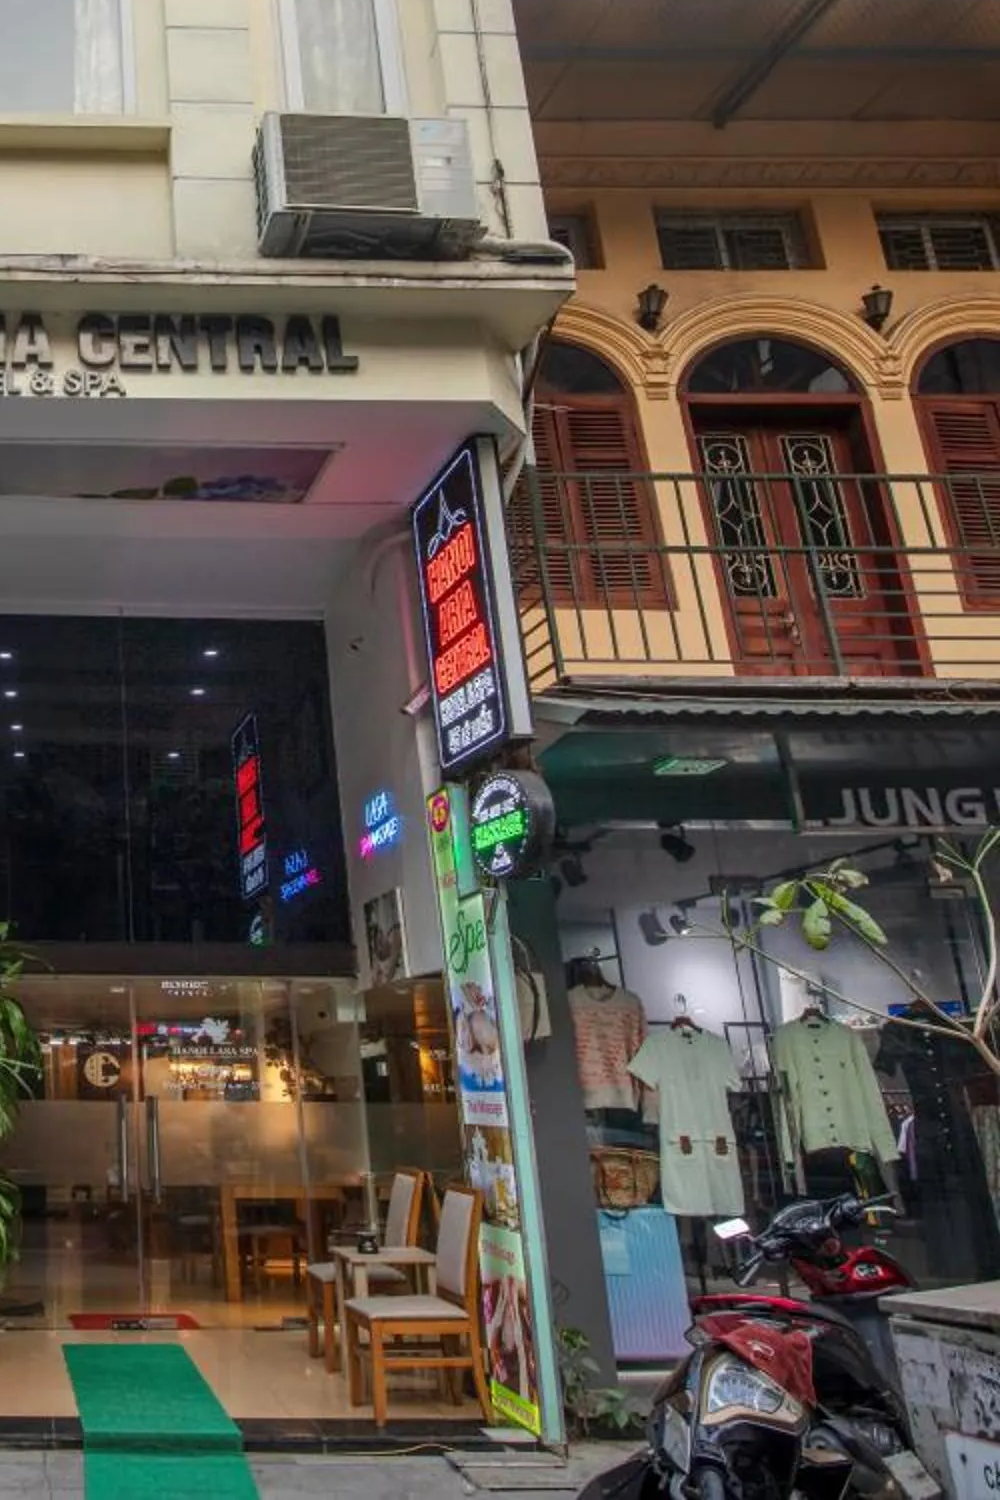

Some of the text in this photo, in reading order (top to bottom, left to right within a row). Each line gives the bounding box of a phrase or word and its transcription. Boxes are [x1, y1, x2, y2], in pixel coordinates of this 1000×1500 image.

[77, 310, 359, 373] CENTRAL
[31, 371, 54, 396] &
[63, 370, 127, 397] SPA
[828, 787, 1000, 826] JUNG
